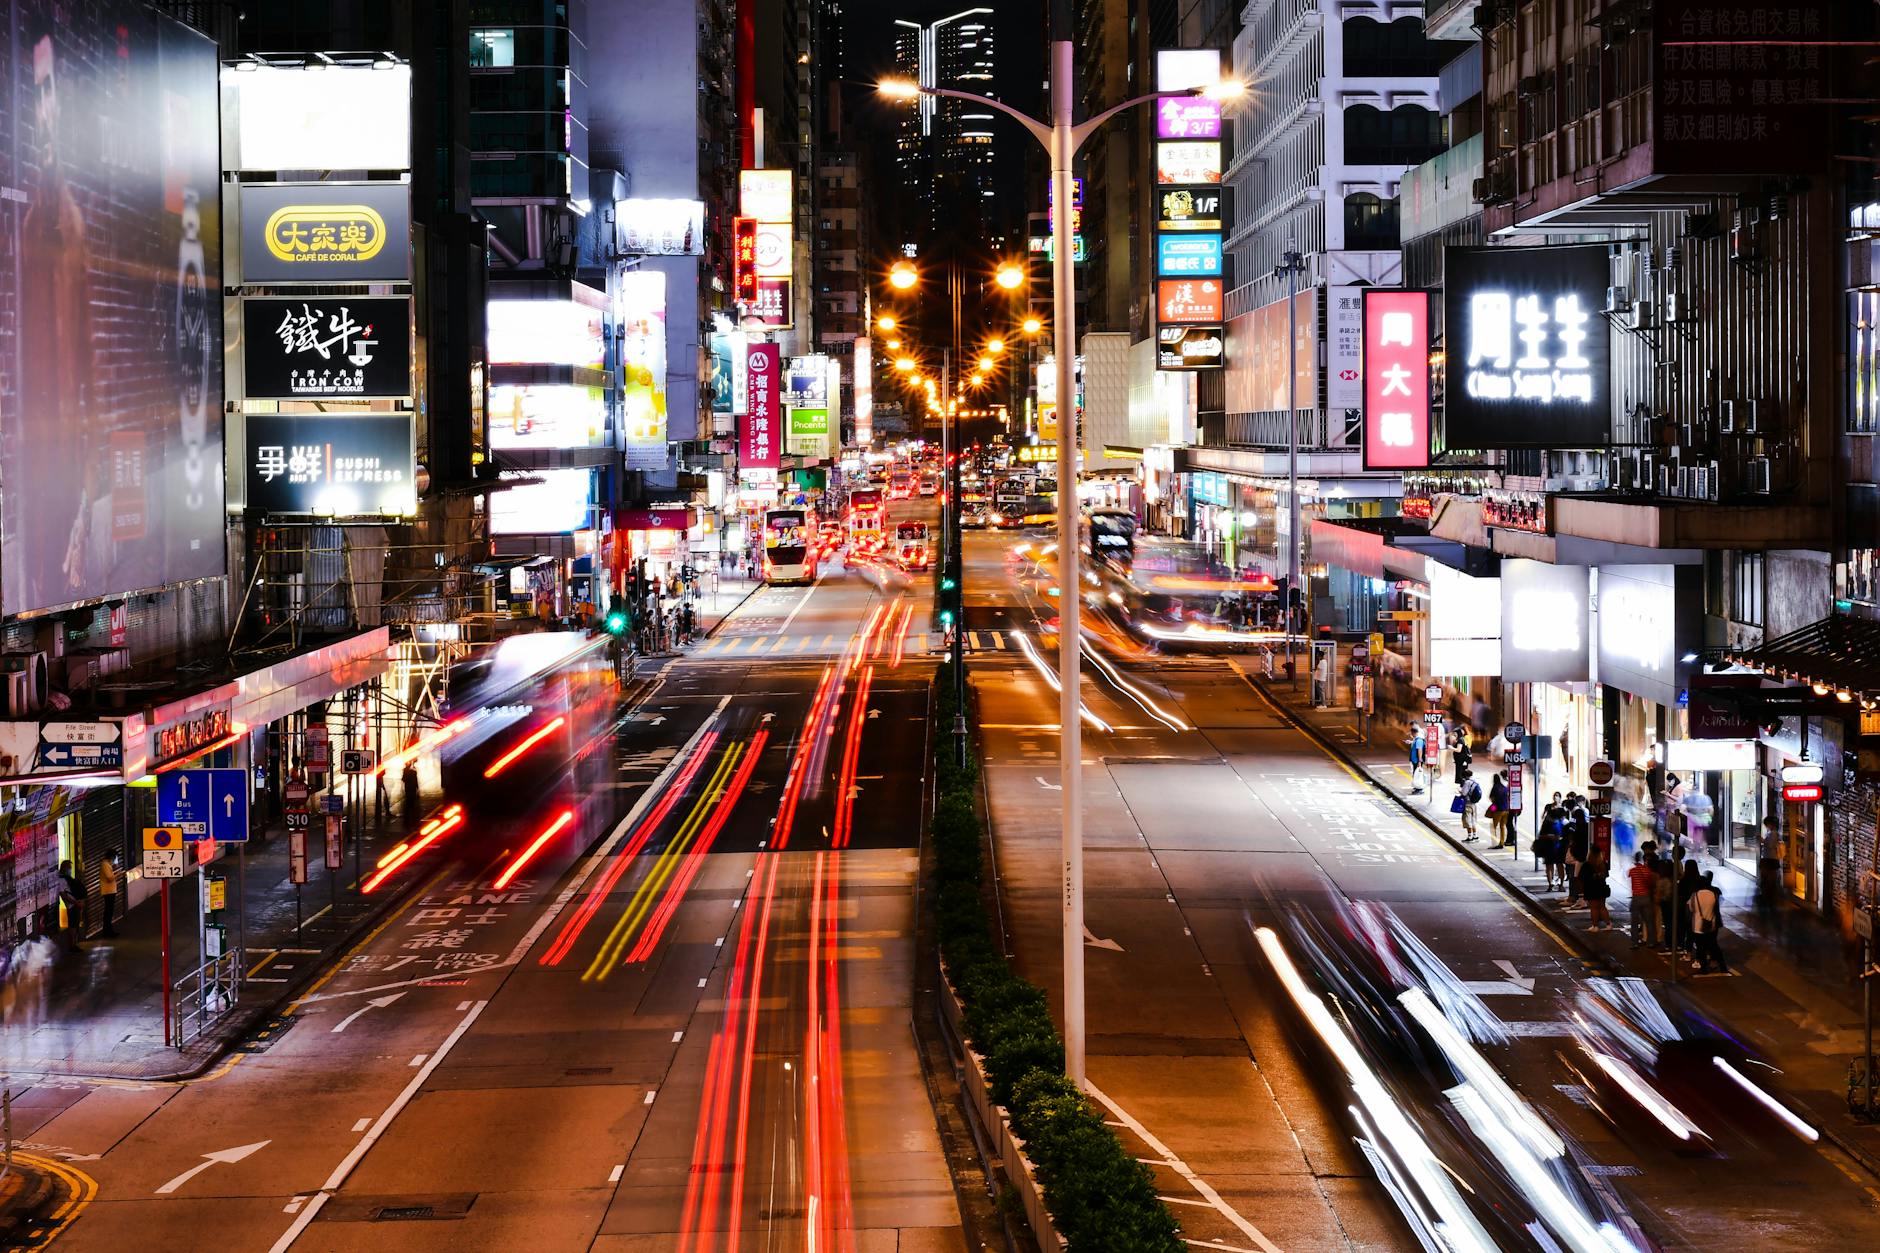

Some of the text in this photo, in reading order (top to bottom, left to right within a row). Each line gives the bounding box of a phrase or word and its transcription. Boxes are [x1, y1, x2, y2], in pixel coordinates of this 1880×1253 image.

[1191, 121, 1215, 135] 3/F
[1196, 197, 1219, 213] 1/F
[296, 252, 357, 262] CAFÉ DE CORAL
[1468, 293, 1590, 369] 周生生
[291, 377, 365, 387] IRON COW
[756, 374, 768, 460] 招商永隆銀行
[335, 457, 381, 471] SUSHI
[335, 470, 403, 483] EXPRESS
[1424, 713, 1443, 723] N67
[176, 800, 191, 808] Bus
[1591, 803, 1610, 815] N69
[174, 810, 194, 820] 巴士
[287, 814, 309, 826] S10
[199, 824, 205, 832] 8
[168, 851, 175, 861] 7
[169, 866, 181, 876] 12
[417, 893, 538, 906] LANE
[405, 907, 508, 926] 巴士
[475, 953, 500, 968] 8
